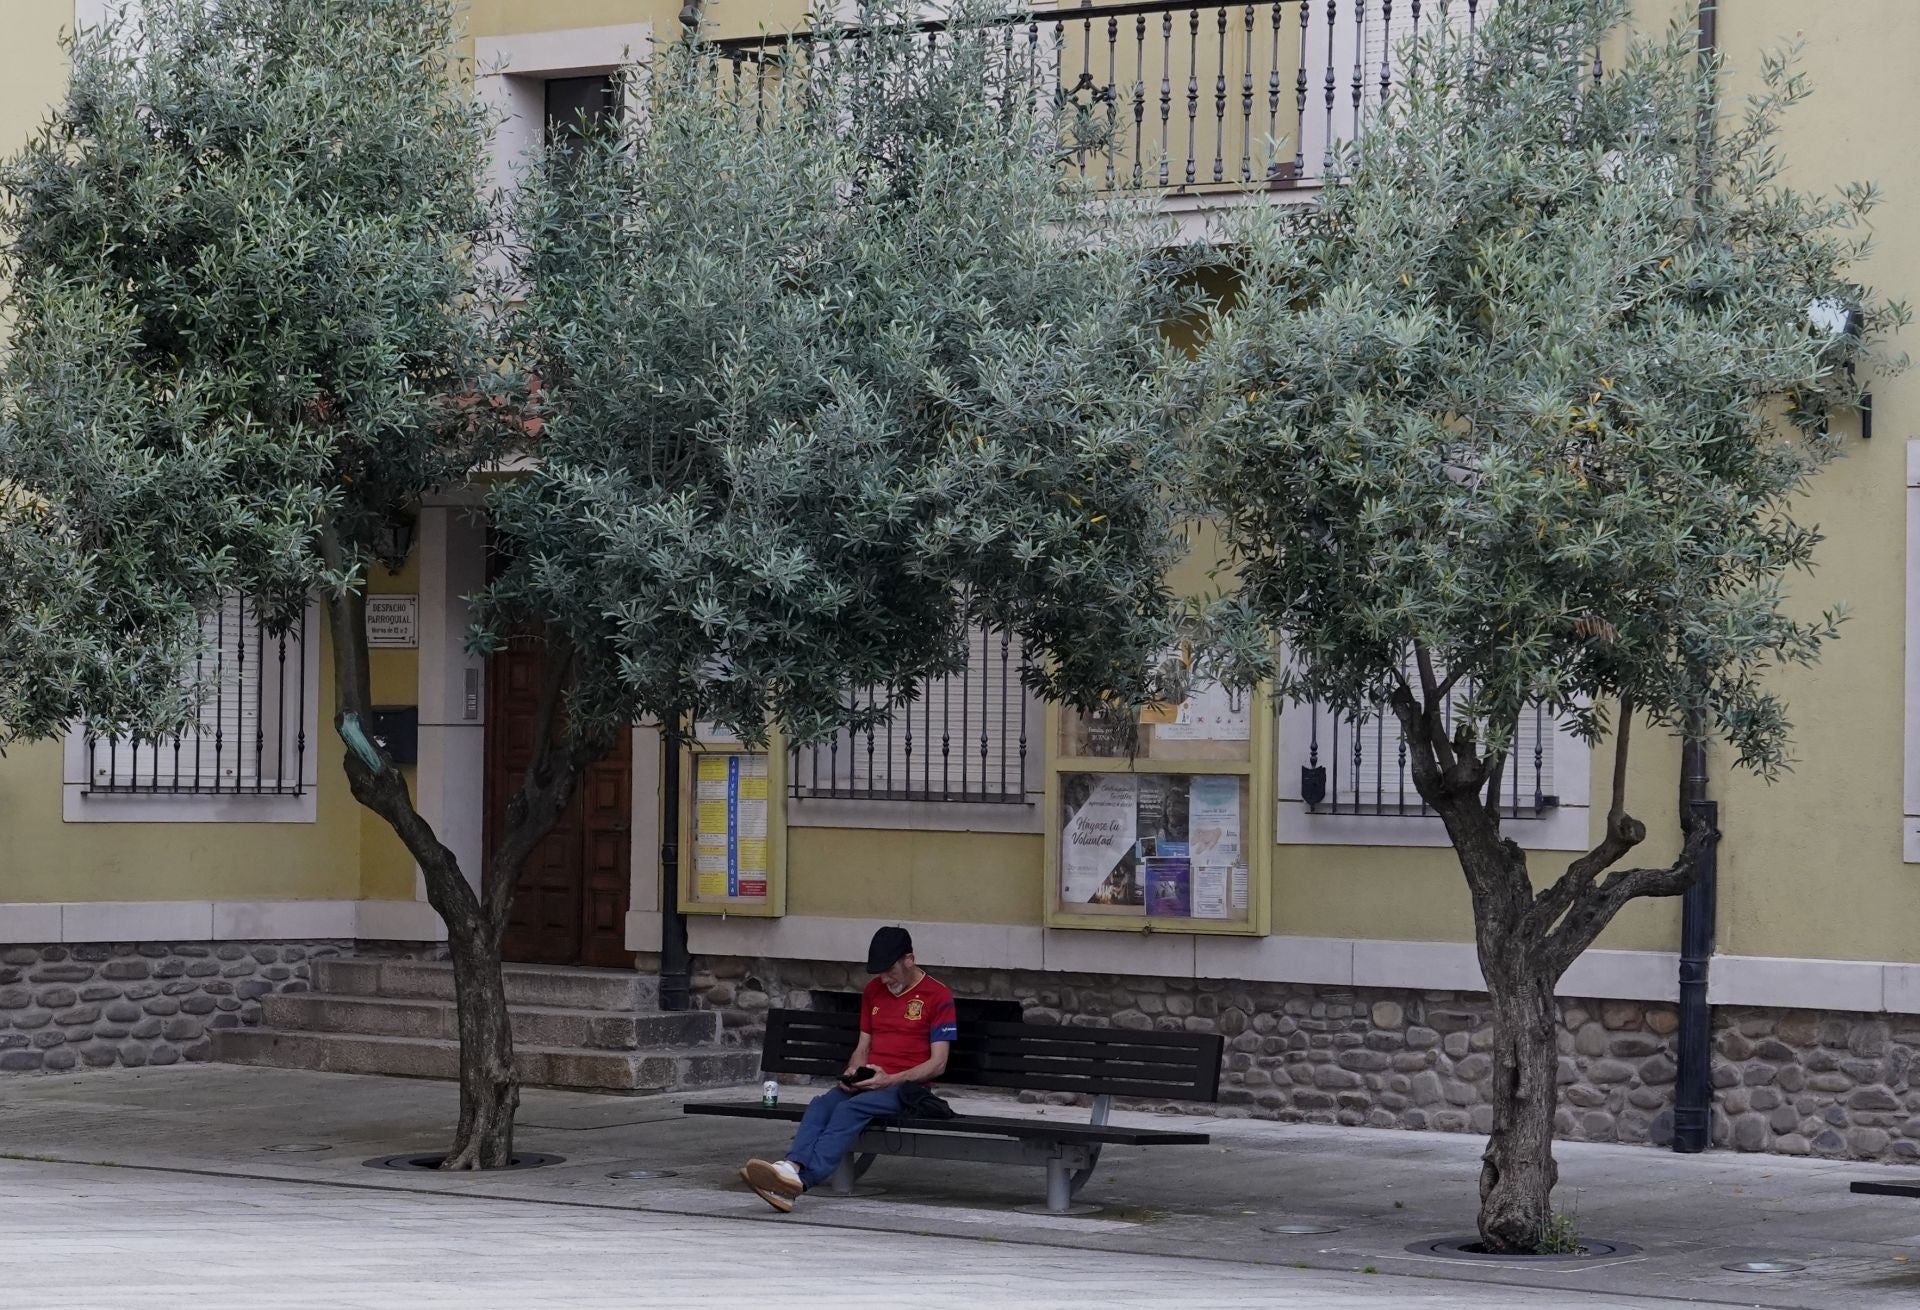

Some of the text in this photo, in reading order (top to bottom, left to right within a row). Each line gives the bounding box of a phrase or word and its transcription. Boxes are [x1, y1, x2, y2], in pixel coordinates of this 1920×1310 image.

[372, 603, 405, 612] DESPACHO
[367, 615, 412, 624] PARROQUIAL
[1109, 819, 1120, 832] tu
[1072, 831, 1114, 846] Voluntad
